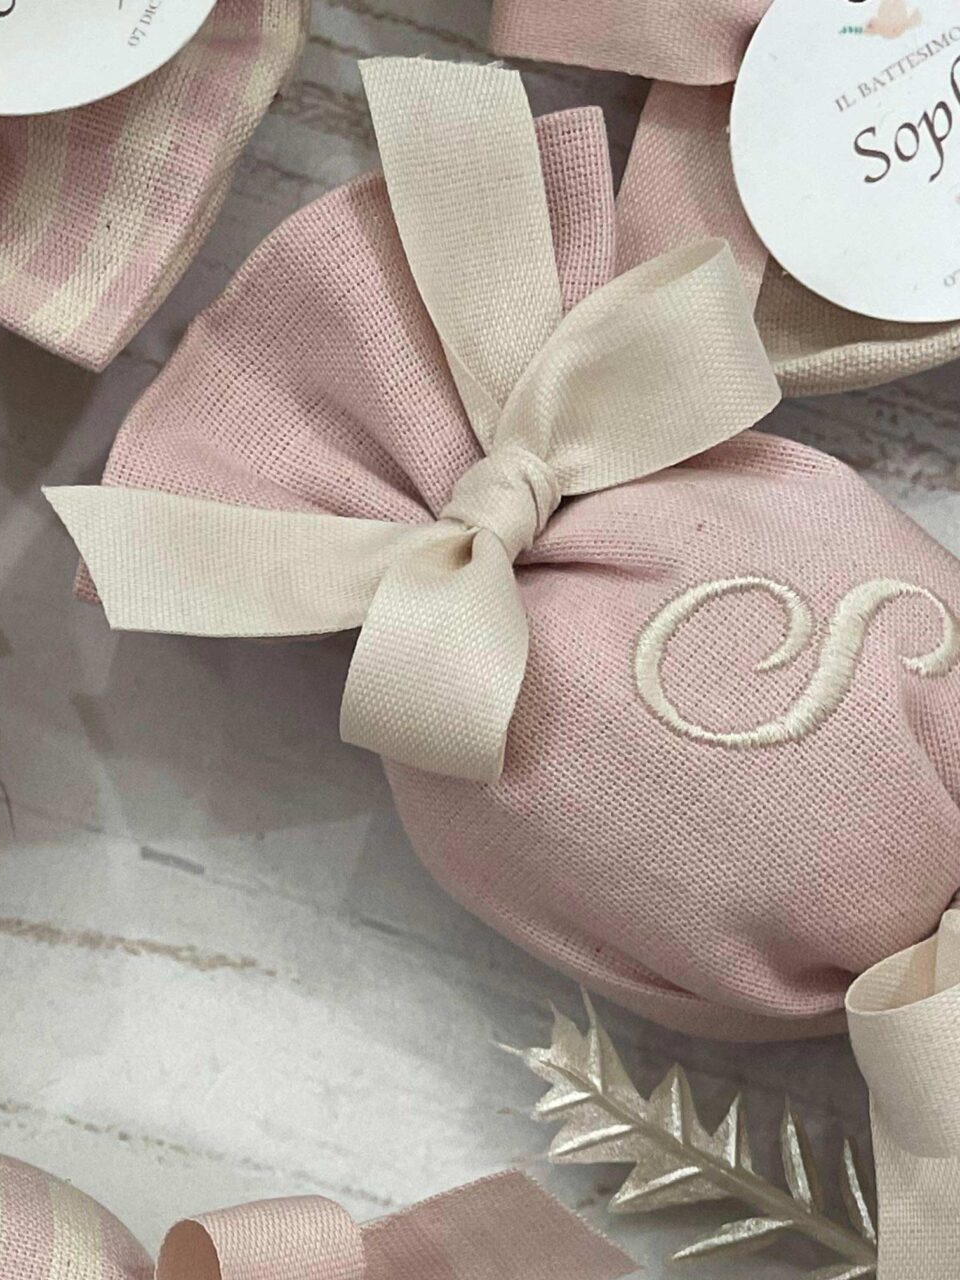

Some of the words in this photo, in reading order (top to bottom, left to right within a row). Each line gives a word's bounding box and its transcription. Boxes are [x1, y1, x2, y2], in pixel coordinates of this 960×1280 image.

[128, 27, 146, 46] 07
[833, 95, 857, 113] IL
[857, 26, 960, 98] BATTESIMO
